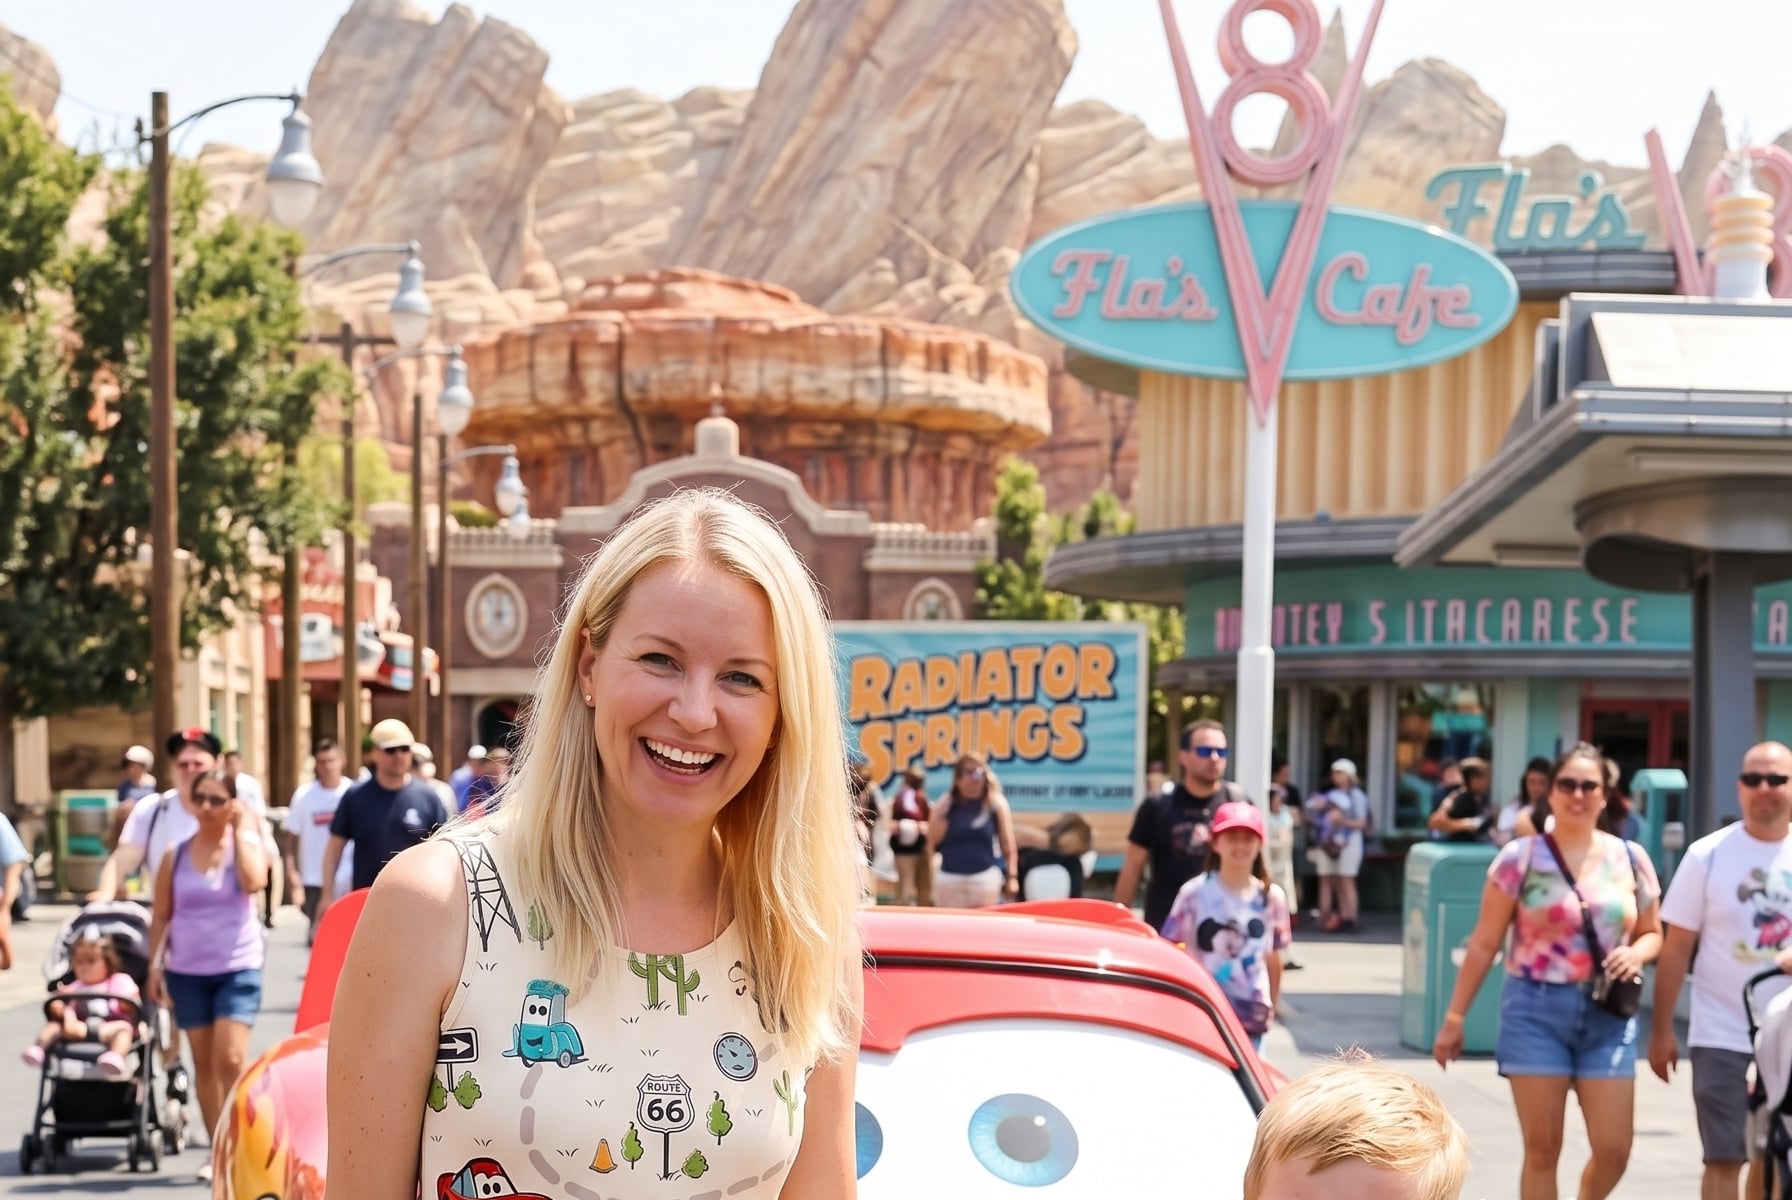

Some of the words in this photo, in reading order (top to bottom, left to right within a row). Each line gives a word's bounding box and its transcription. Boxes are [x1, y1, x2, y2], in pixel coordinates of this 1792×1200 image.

[1315, 251, 1484, 347] Cafe
[850, 642, 1117, 723] RADIATOR
[858, 703, 1087, 790] SPRINGS
[647, 1082, 681, 1093] ROUTE
[647, 1098, 685, 1123] 66
